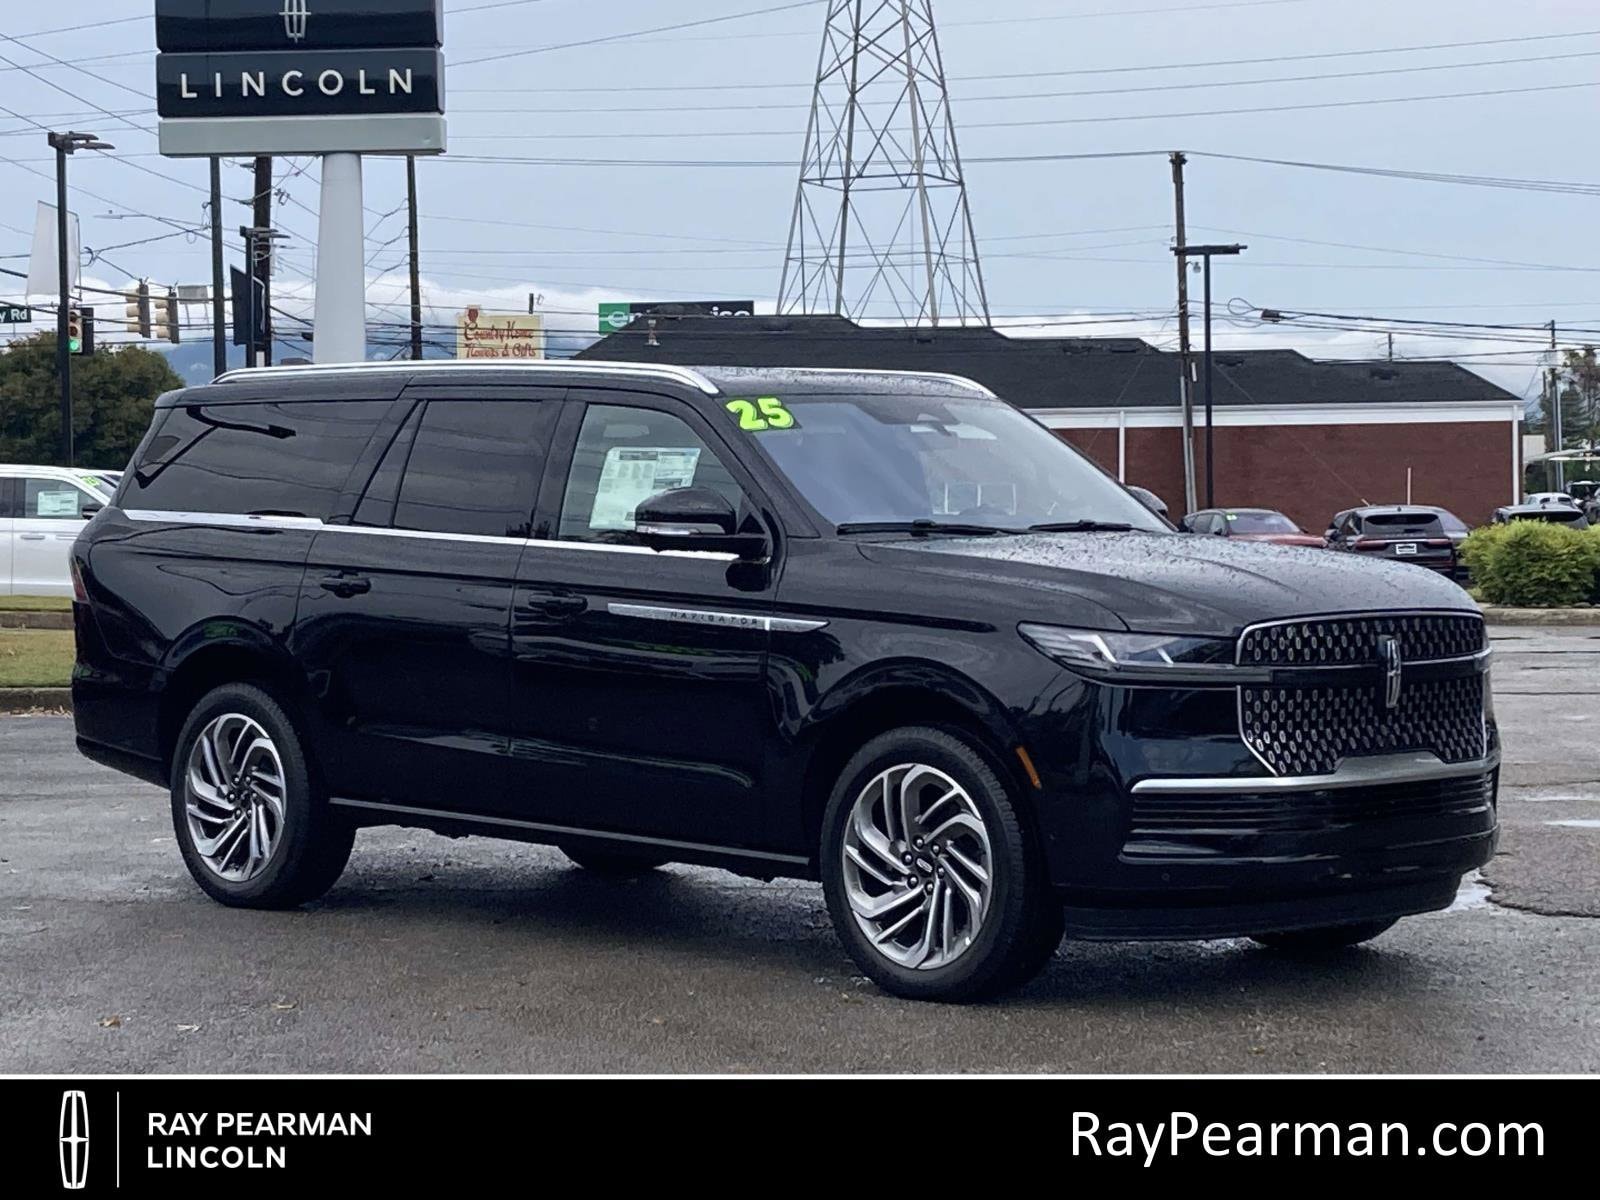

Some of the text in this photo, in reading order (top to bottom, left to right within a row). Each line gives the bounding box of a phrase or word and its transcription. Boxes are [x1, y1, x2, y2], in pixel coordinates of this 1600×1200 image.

[181, 68, 412, 98] LINCOLN
[11, 308, 27, 320] Rd
[725, 397, 796, 431] 25
[670, 611, 758, 626] NAVIGATOR
